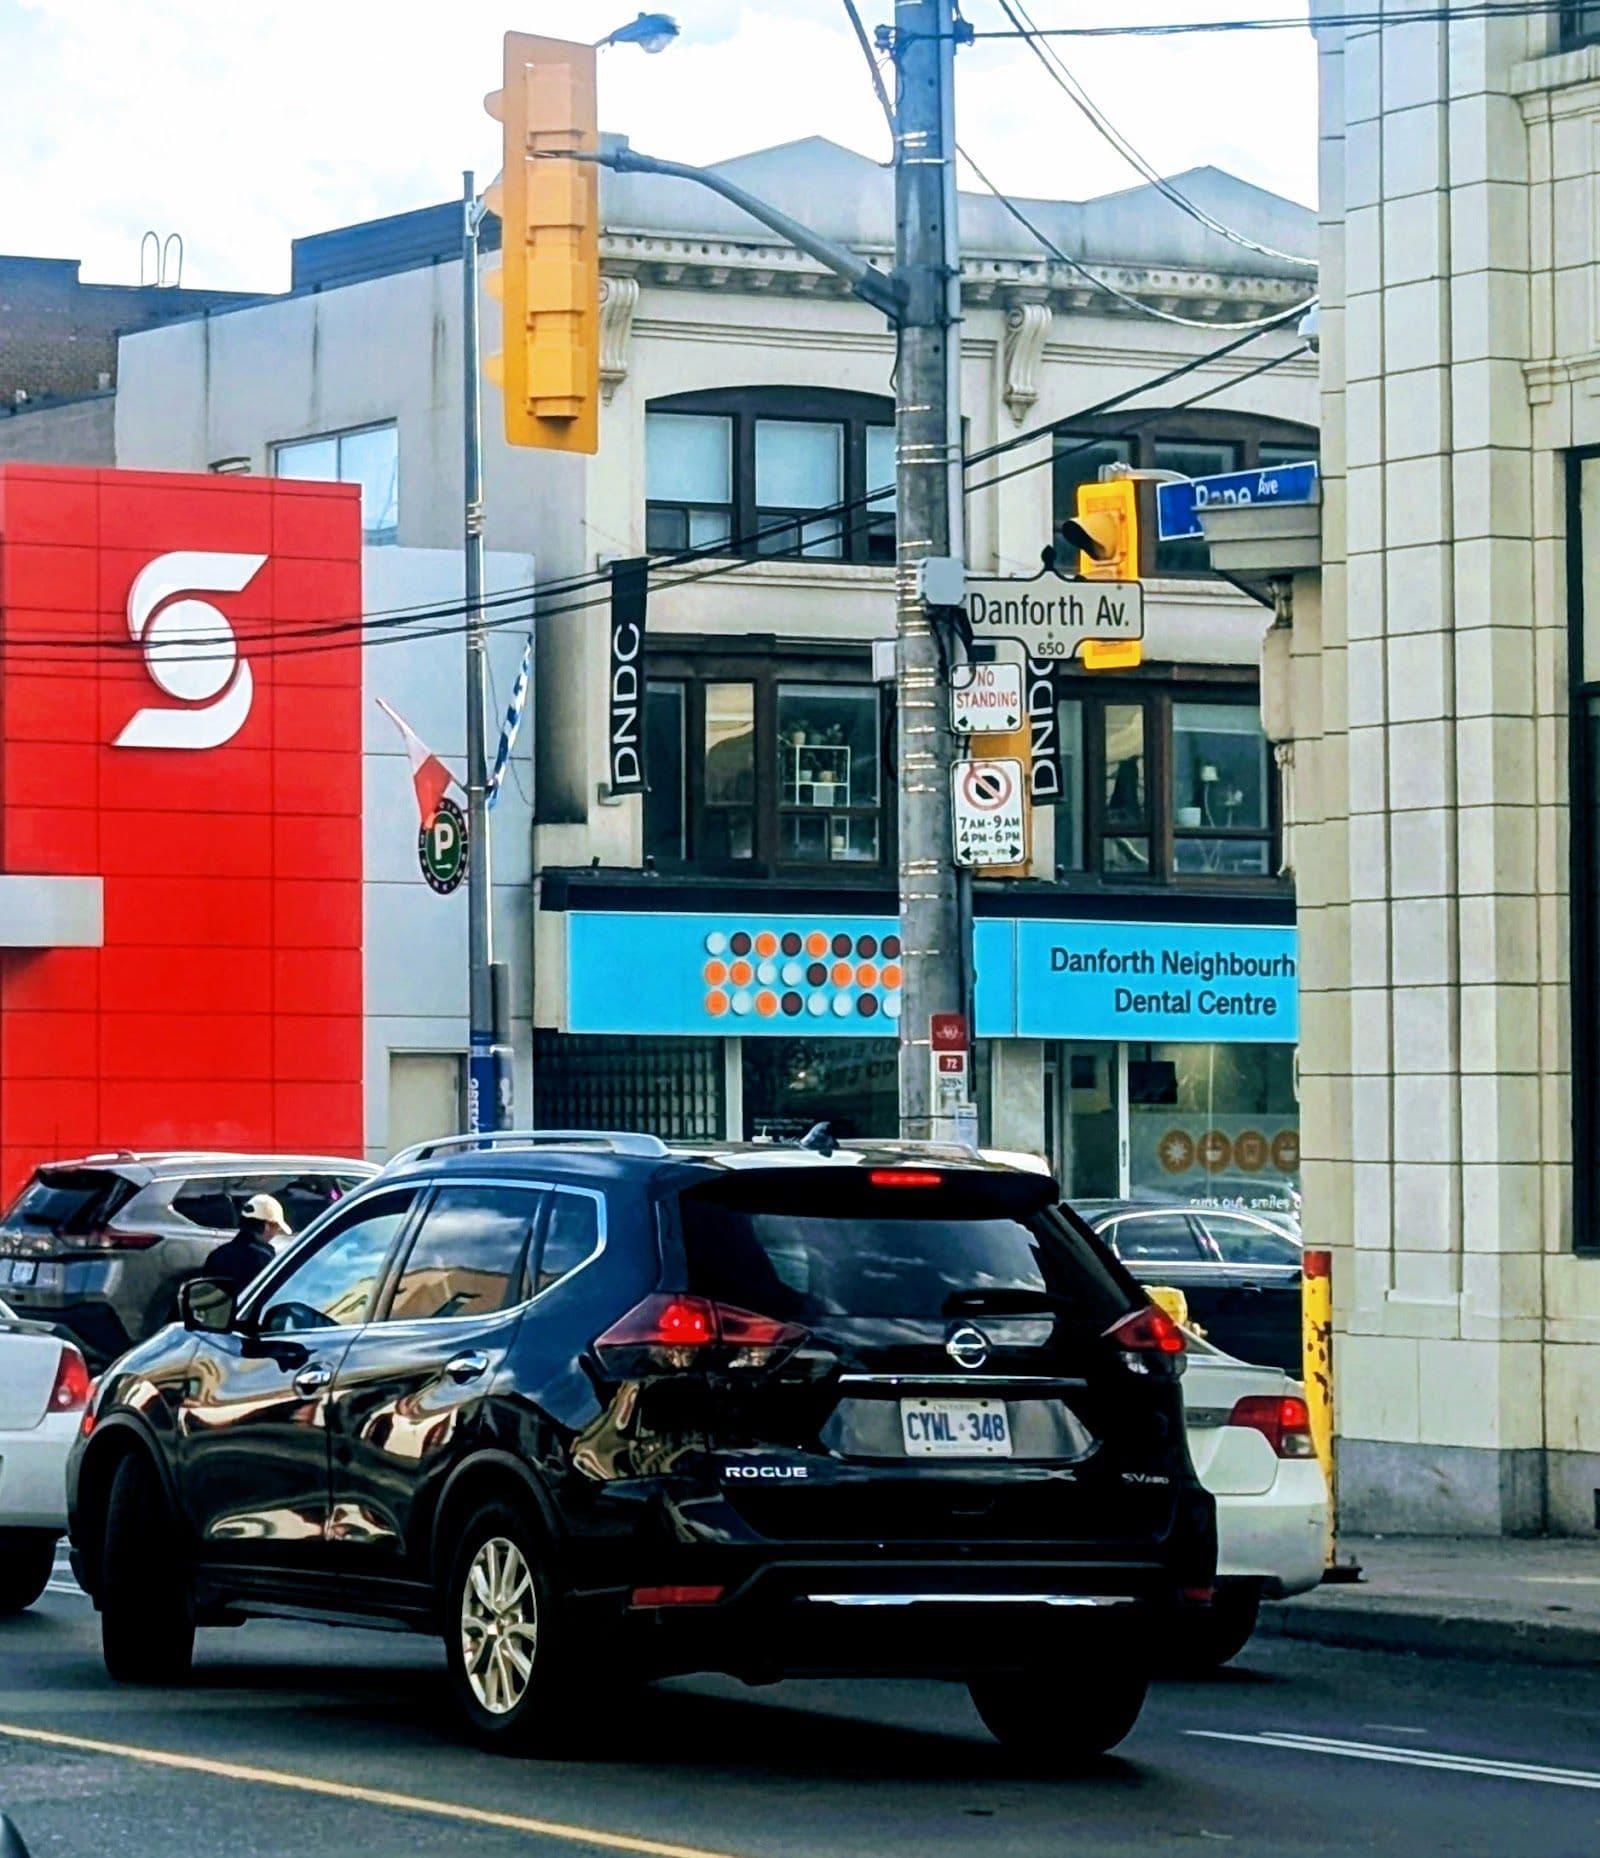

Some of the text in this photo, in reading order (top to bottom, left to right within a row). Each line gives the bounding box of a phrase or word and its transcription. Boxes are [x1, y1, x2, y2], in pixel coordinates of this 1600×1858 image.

[1257, 478, 1279, 497] Ave
[970, 592, 1129, 626] Danforth Av.
[1038, 642, 1065, 655] 650
[977, 671, 994, 686] NO
[613, 622, 641, 784] DNDC
[956, 691, 1018, 708] STANDING
[434, 823, 453, 860] P
[1051, 947, 1295, 982] Danforth Neighbourh
[1115, 988, 1277, 1016] Dental Centre
[967, 1412, 1006, 1441] 348
[725, 1466, 809, 1478] ROGUE
